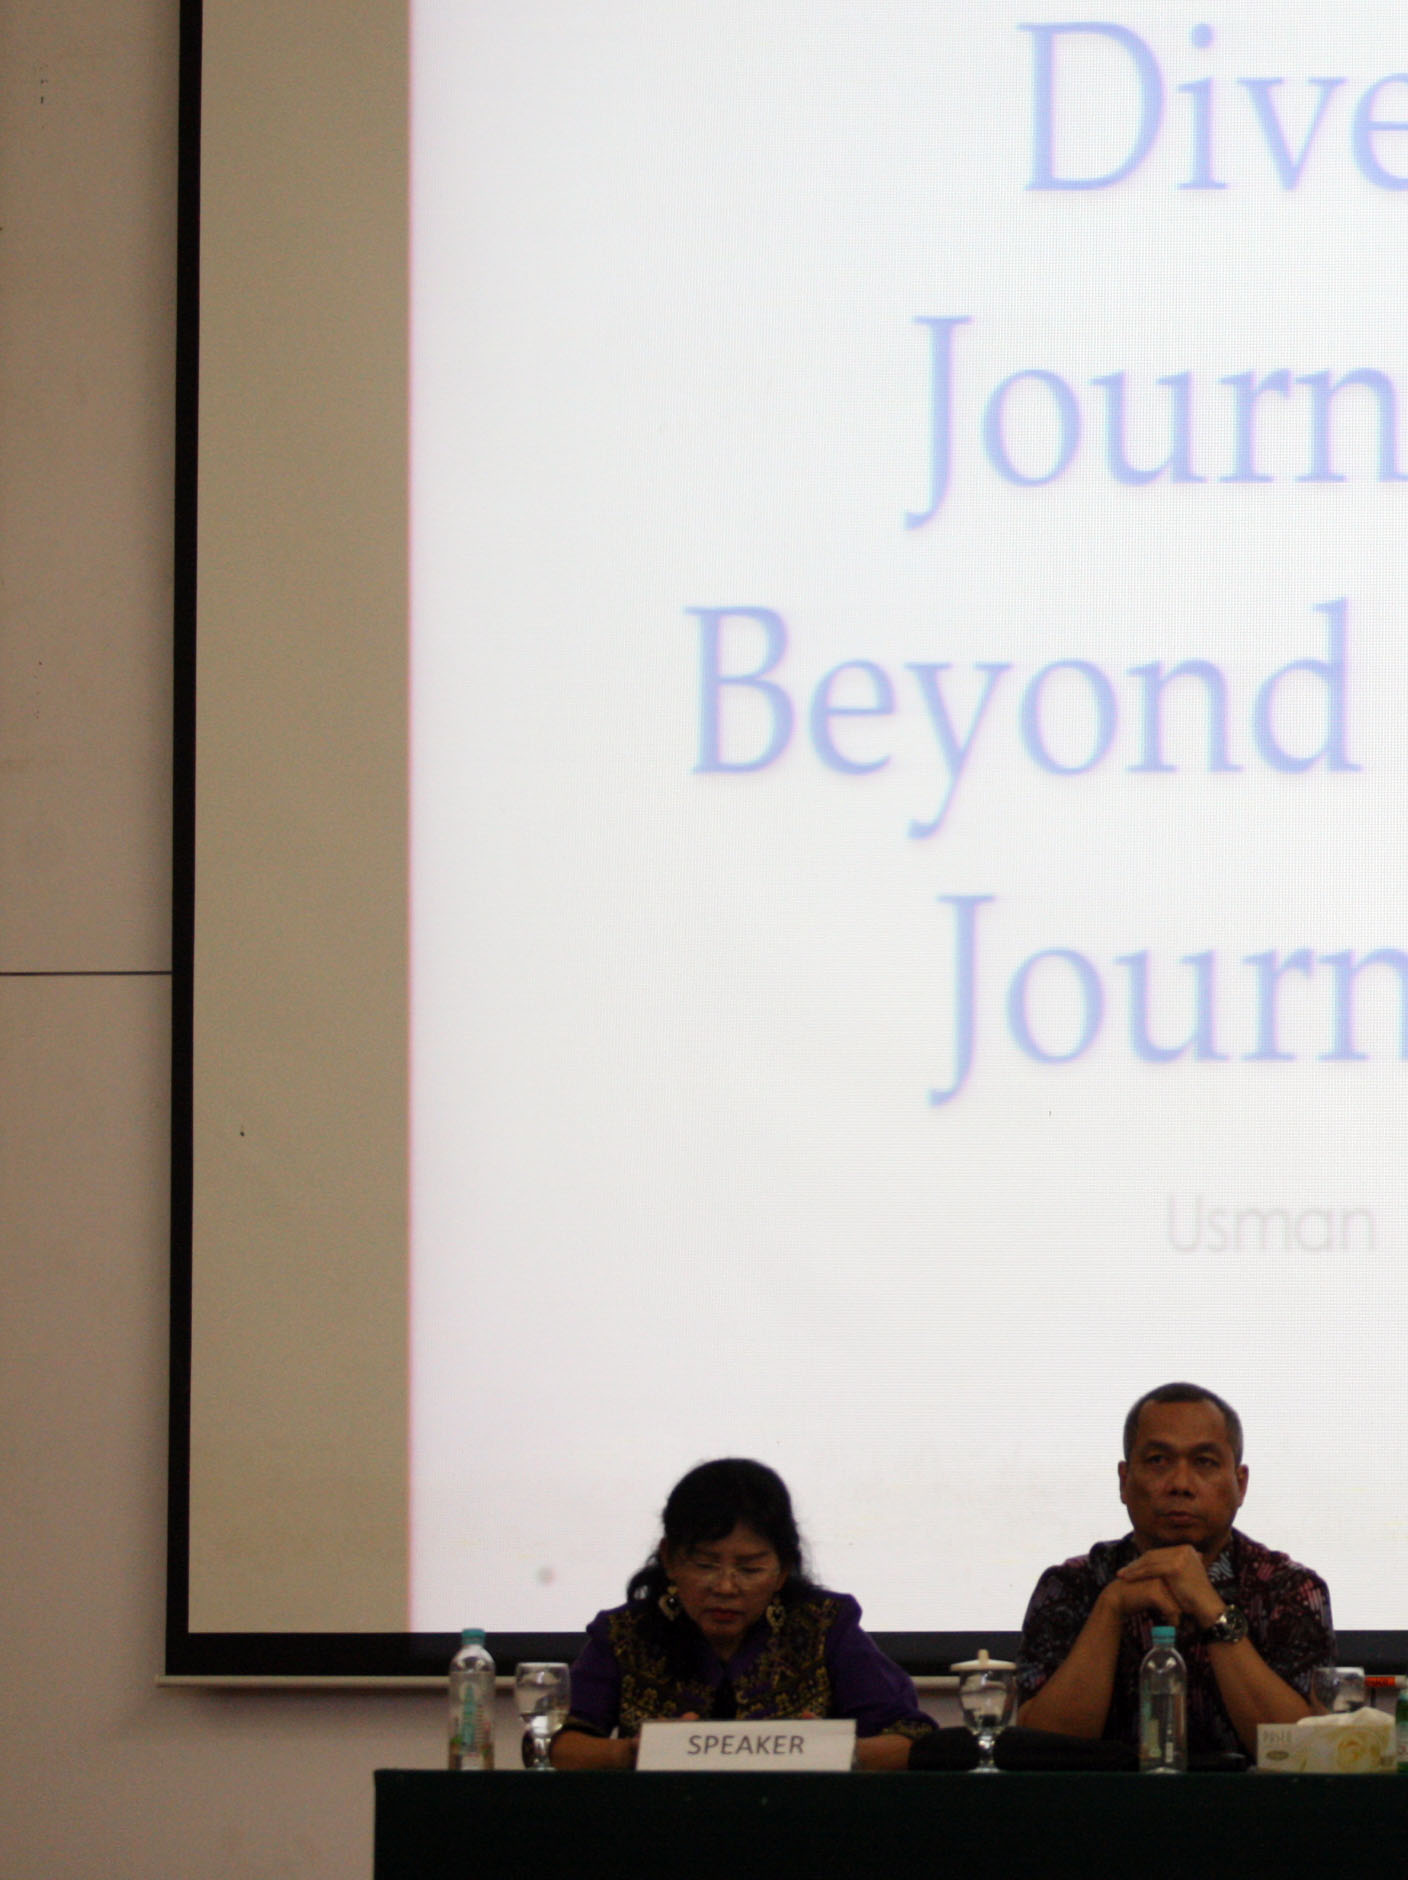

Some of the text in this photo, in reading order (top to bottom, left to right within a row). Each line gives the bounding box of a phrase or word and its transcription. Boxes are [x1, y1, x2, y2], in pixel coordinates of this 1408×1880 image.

[682, 597, 1363, 840] Beyond
[1166, 1194, 1377, 1254] Usman
[688, 1735, 805, 1756] SPEAKER
